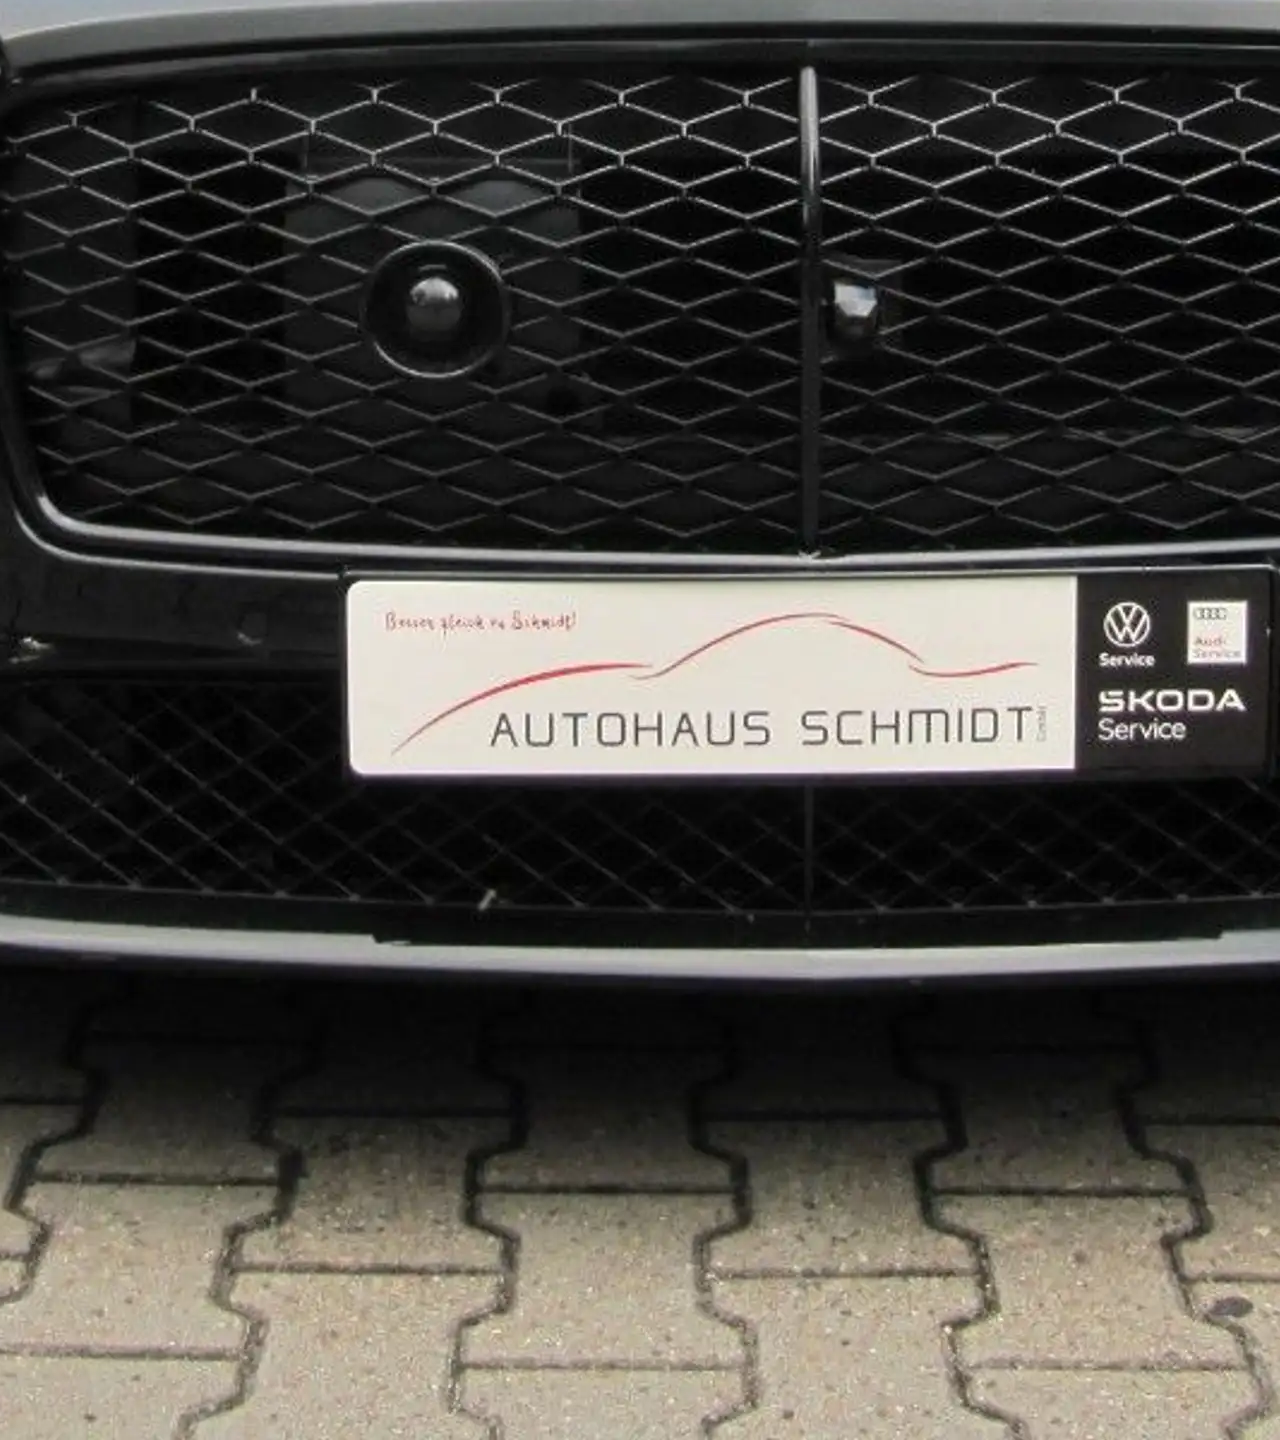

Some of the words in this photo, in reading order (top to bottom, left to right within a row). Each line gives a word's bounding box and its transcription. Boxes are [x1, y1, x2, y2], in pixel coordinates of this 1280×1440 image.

[1098, 652, 1156, 667] Service
[490, 711, 772, 747] AUTOHAUS
[800, 706, 1034, 744] SCHMIDT
[1098, 717, 1187, 741] Service
